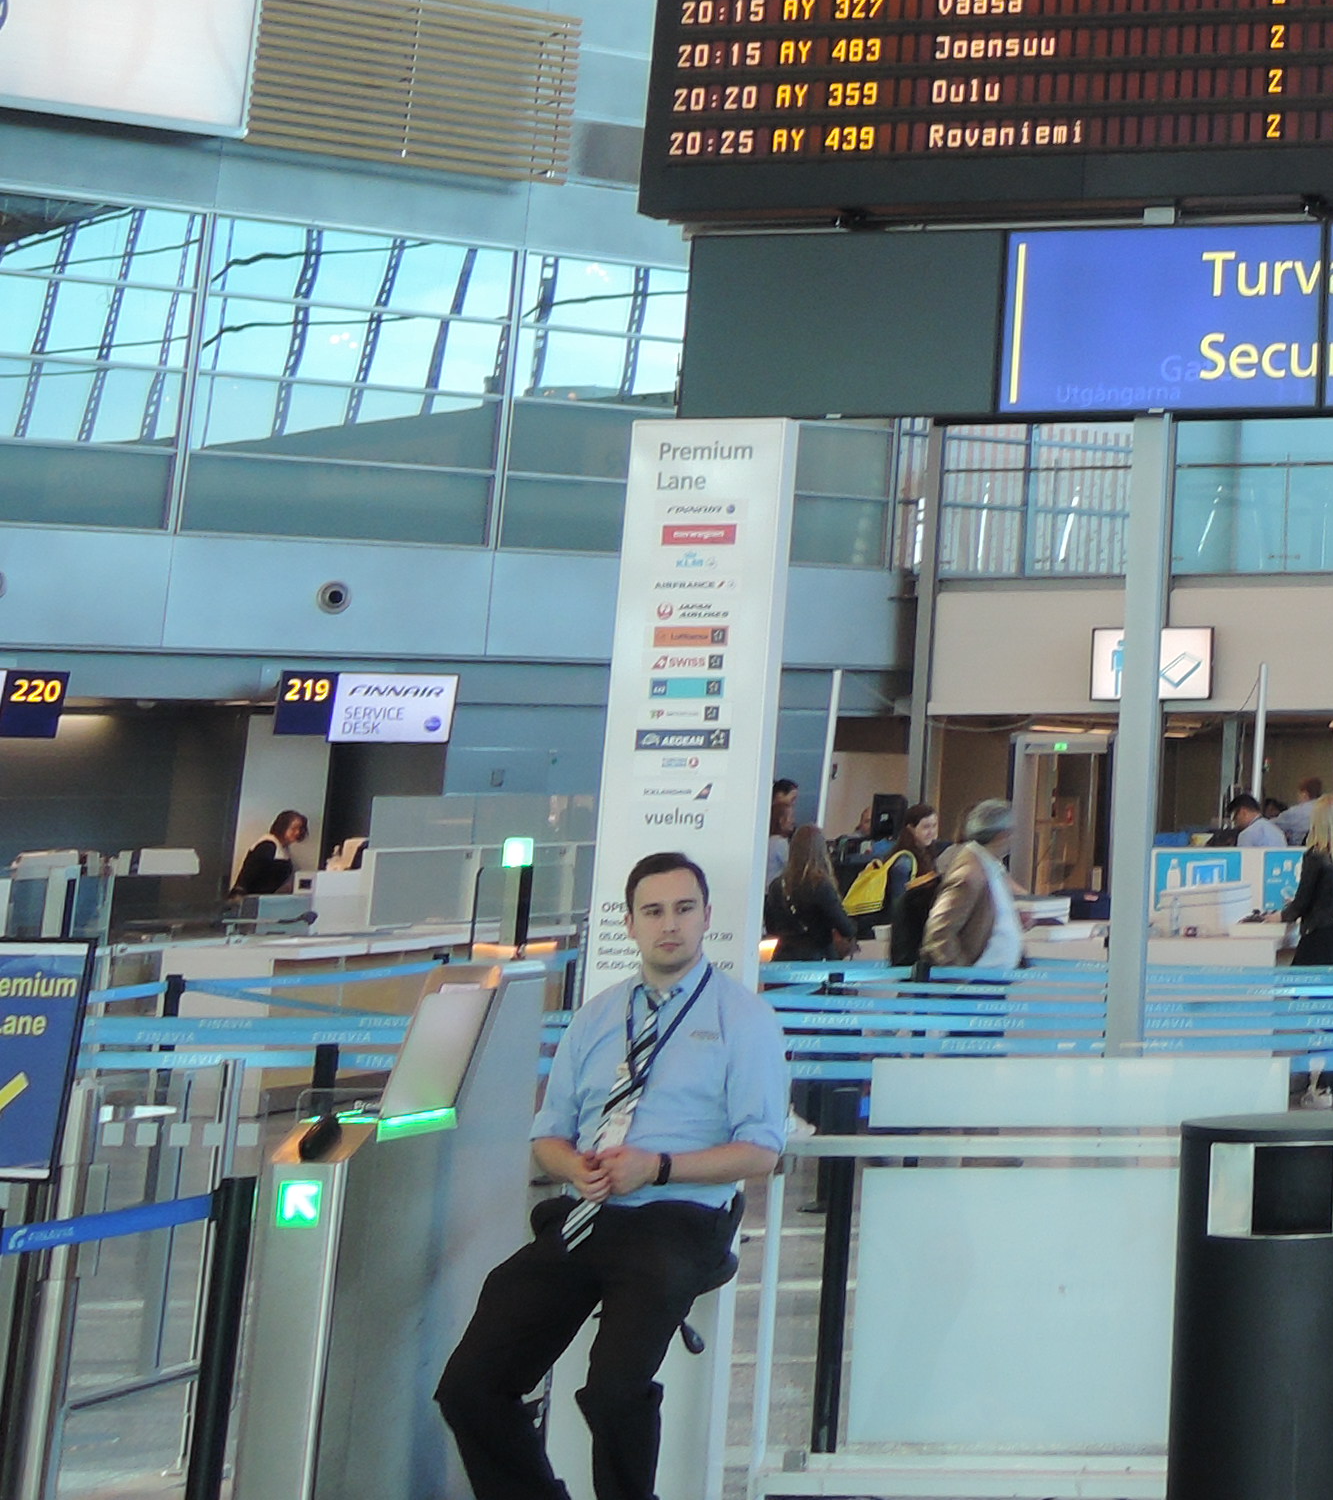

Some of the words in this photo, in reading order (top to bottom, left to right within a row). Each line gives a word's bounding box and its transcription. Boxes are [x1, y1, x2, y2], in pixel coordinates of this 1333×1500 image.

[936, 36, 1055, 59] Joensuu
[933, 79, 999, 102] Oulu
[929, 120, 1080, 147] Rovaniemi
[659, 441, 753, 461] Premium
[657, 472, 706, 490] Lane
[669, 657, 705, 668] SWISS
[11, 680, 61, 702] 220
[285, 679, 329, 701] 219
[348, 684, 444, 699] FINNAIR
[343, 706, 405, 721] SERVICE
[341, 720, 384, 735] DESK
[645, 808, 706, 829] vueling
[0, 1015, 47, 1035] ane
